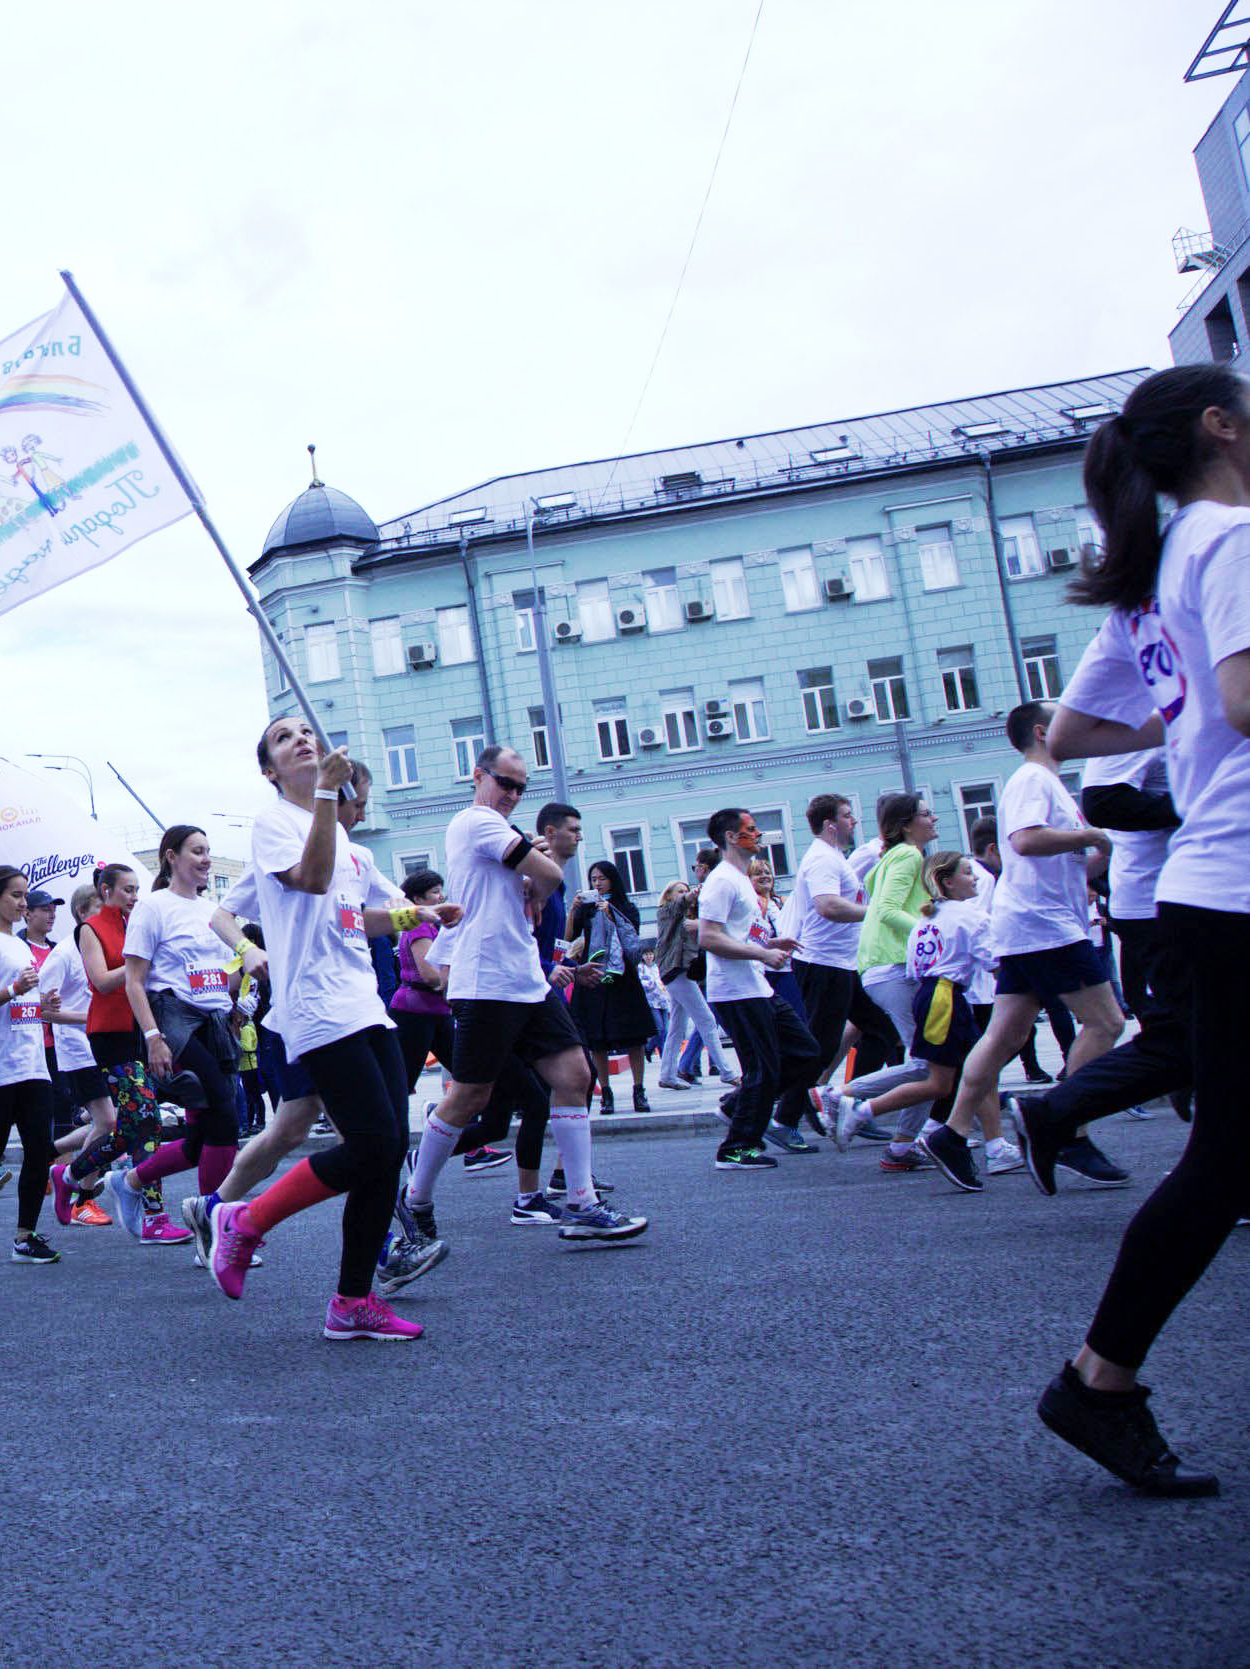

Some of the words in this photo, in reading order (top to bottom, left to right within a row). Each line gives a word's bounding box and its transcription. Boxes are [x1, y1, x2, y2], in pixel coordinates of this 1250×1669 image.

[32, 856, 48, 867] The
[202, 973, 223, 986] 281
[22, 1006, 37, 1018] 267
